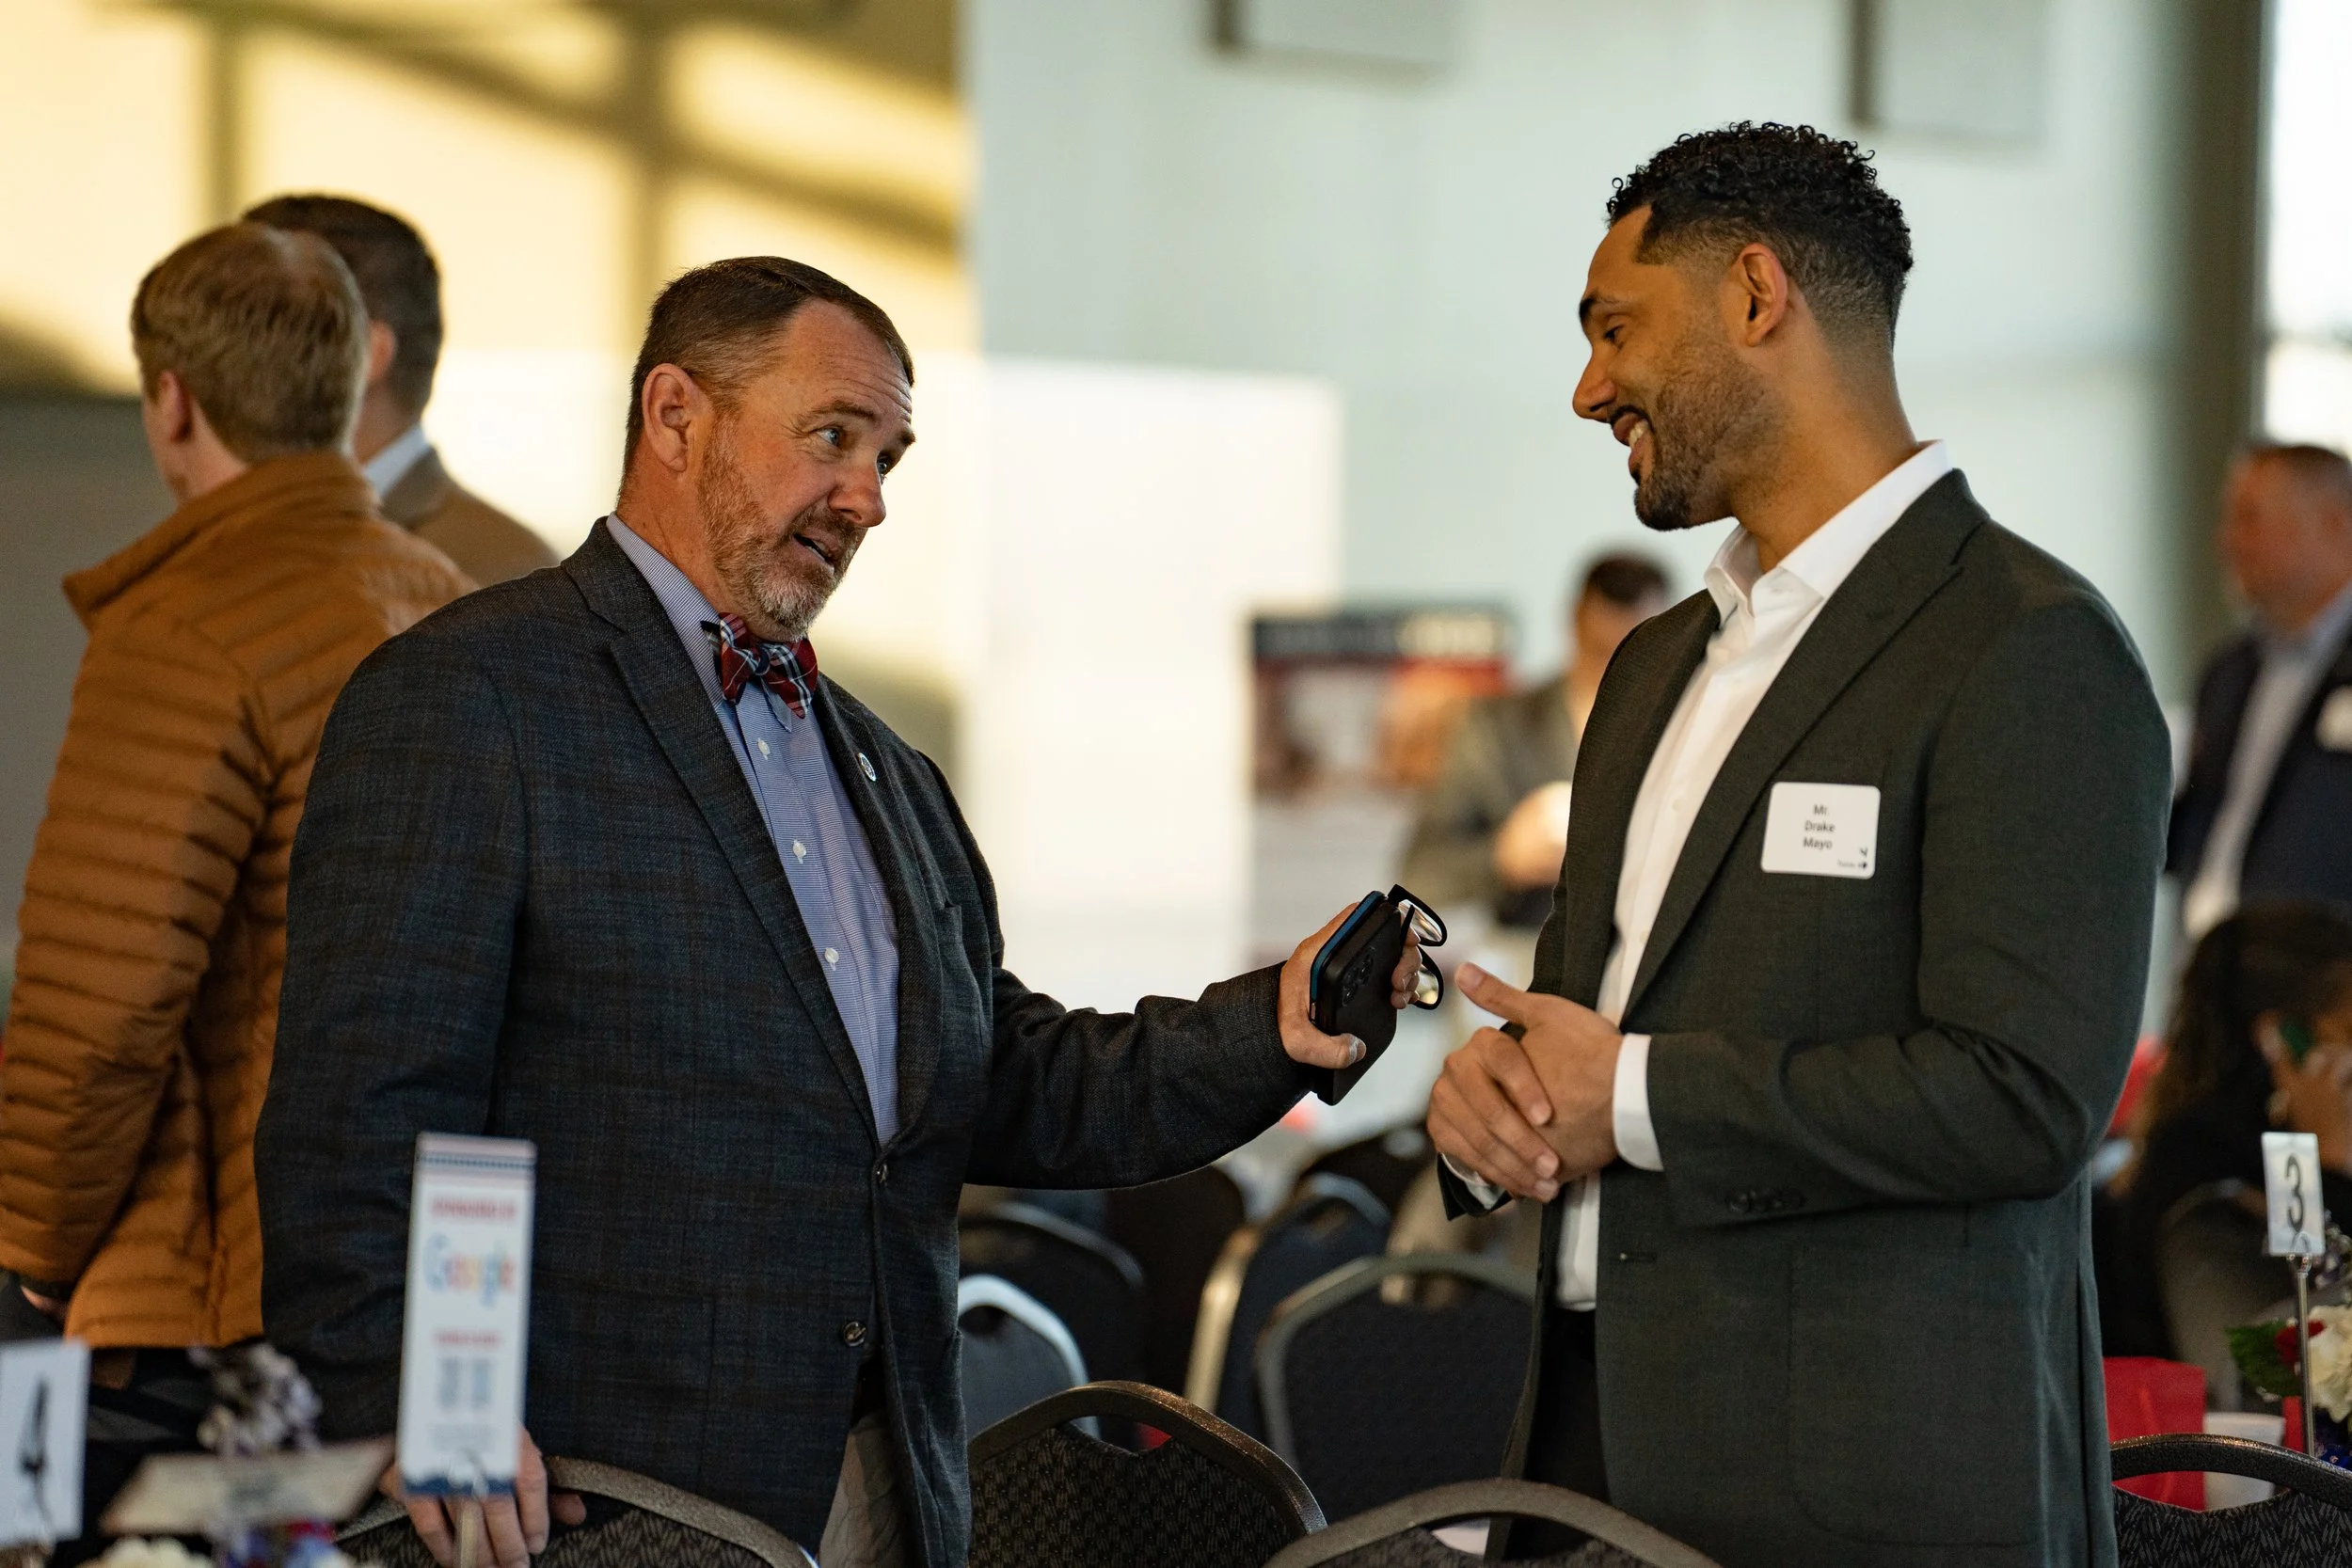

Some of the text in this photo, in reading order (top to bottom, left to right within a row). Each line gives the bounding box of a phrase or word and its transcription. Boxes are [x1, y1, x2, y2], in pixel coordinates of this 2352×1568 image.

[1804, 820, 1836, 832] Drake
[1803, 837, 1833, 850] Mayo
[2284, 1154, 2305, 1233] 3
